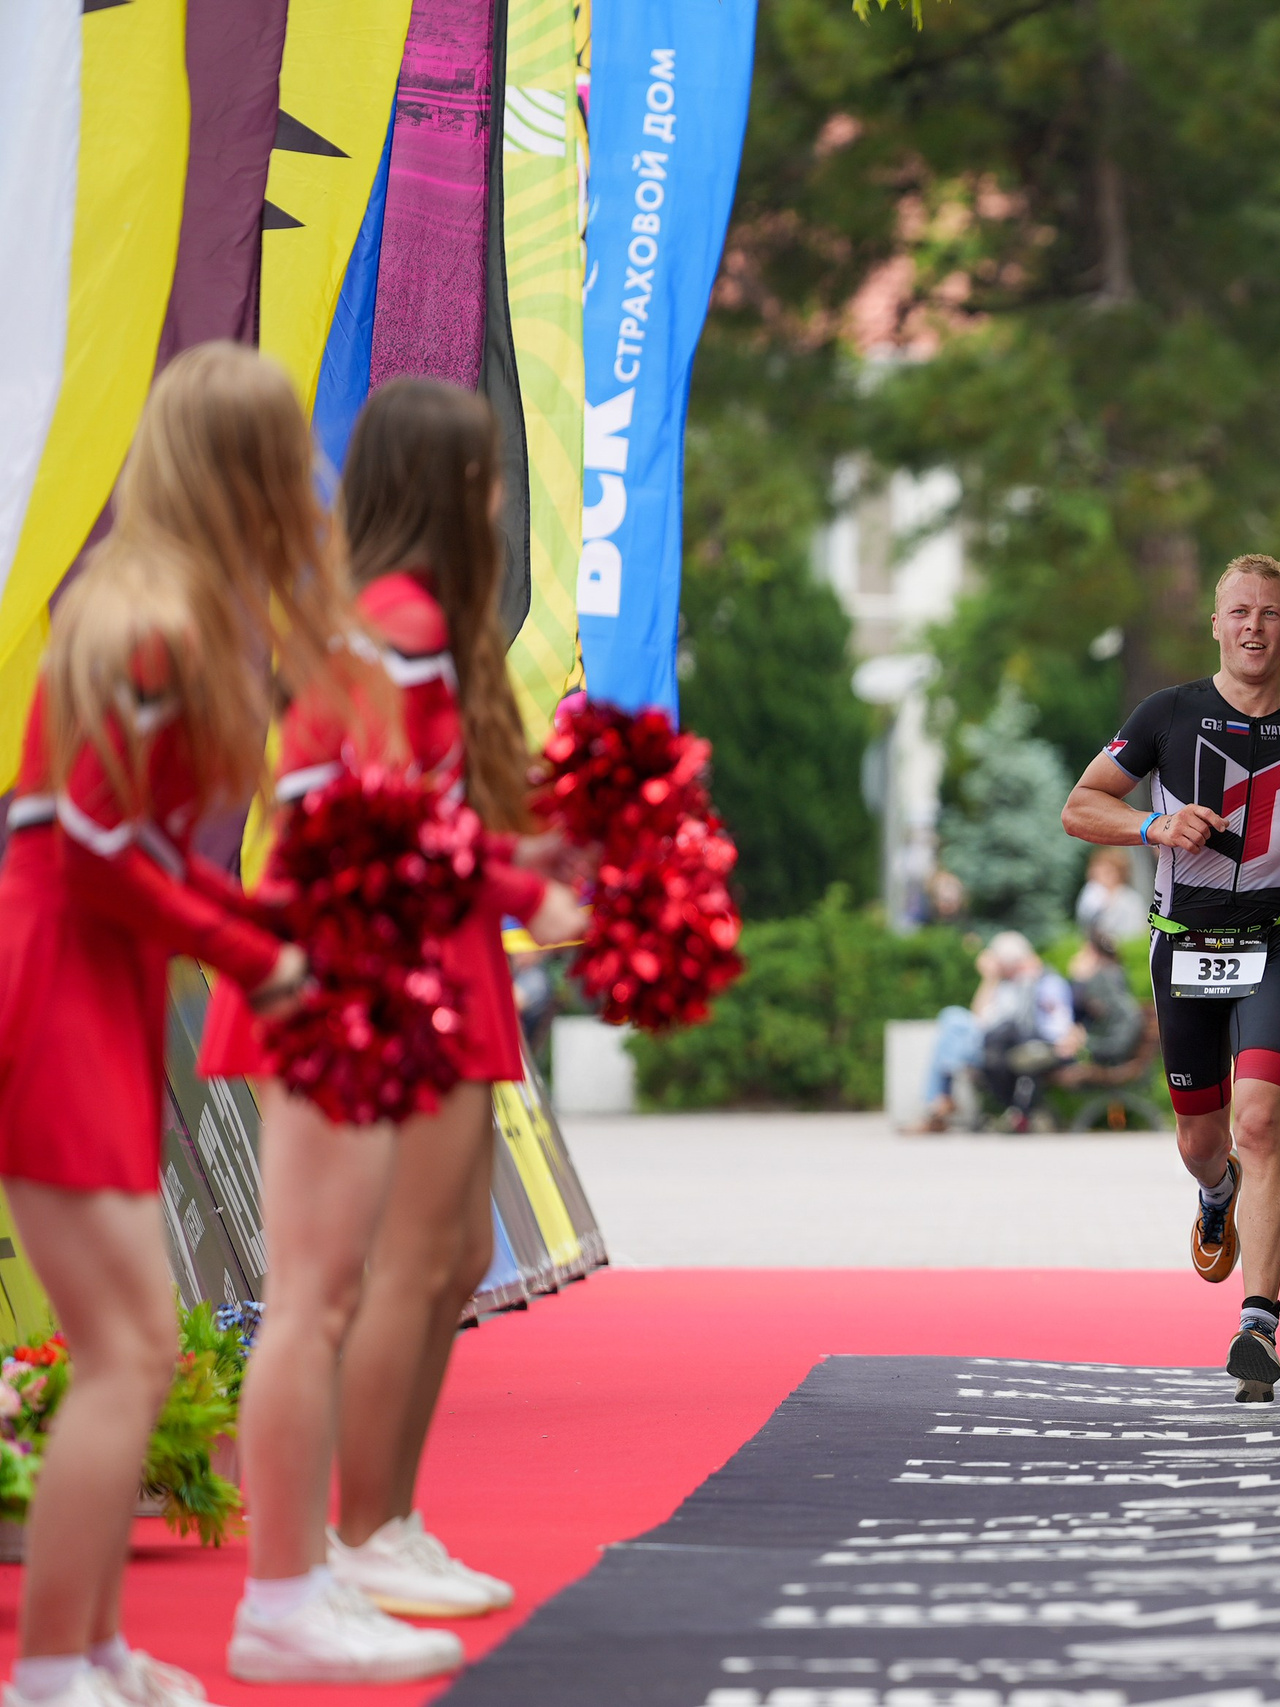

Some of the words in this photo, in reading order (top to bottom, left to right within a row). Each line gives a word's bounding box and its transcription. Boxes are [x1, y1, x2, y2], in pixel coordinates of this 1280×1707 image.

[641, 47, 677, 144] ДОМ
[613, 150, 670, 384] СТРАХОВОЙ
[1198, 958, 1241, 980] 332
[1221, 937, 1235, 945] STAR
